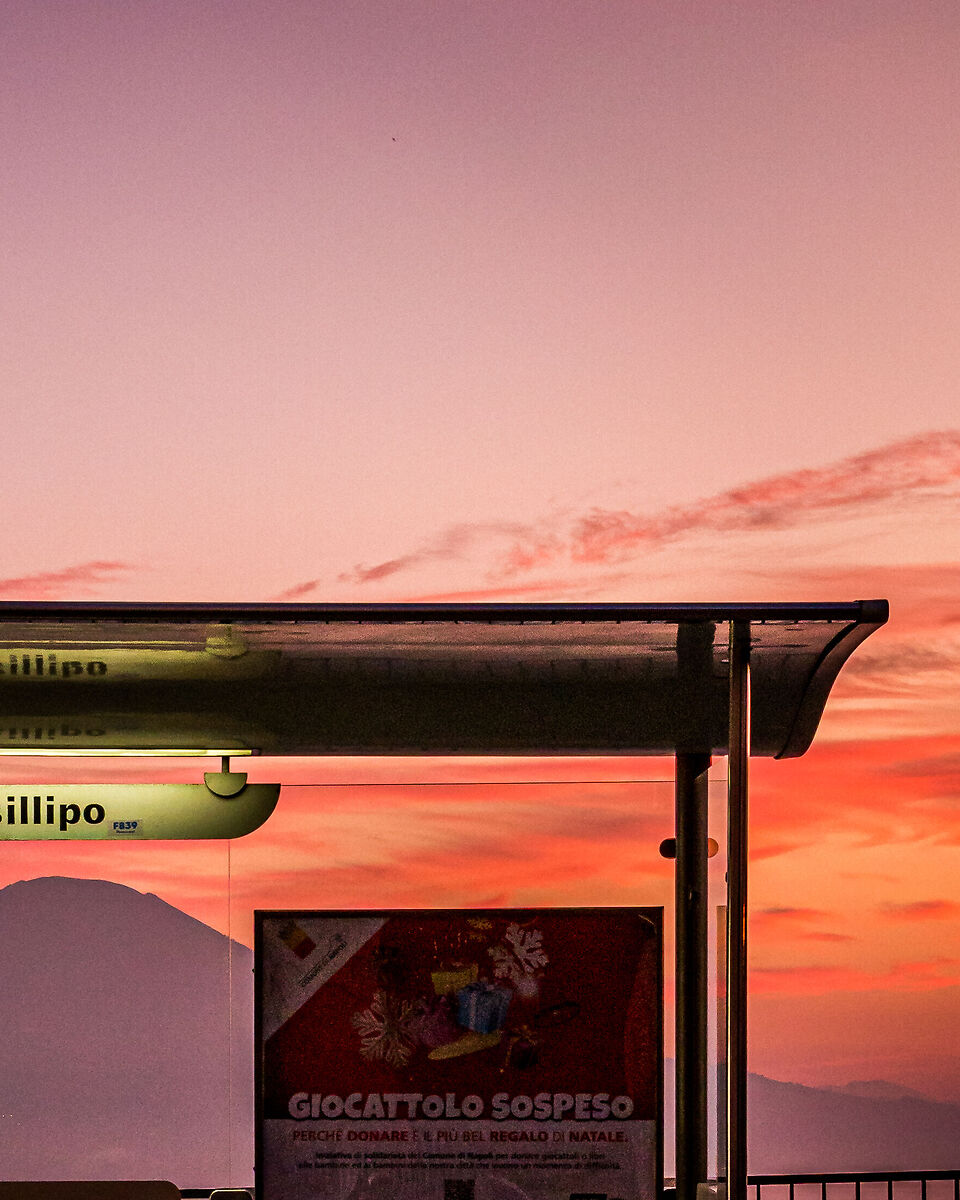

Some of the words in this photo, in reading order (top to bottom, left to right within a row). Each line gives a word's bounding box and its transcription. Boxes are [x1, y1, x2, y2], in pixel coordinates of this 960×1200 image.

[287, 1091, 485, 1121] GIOCATTOLO
[491, 1091, 635, 1121] SOSPESO
[348, 1130, 408, 1142] DONARE
[489, 1130, 549, 1143] REGALO
